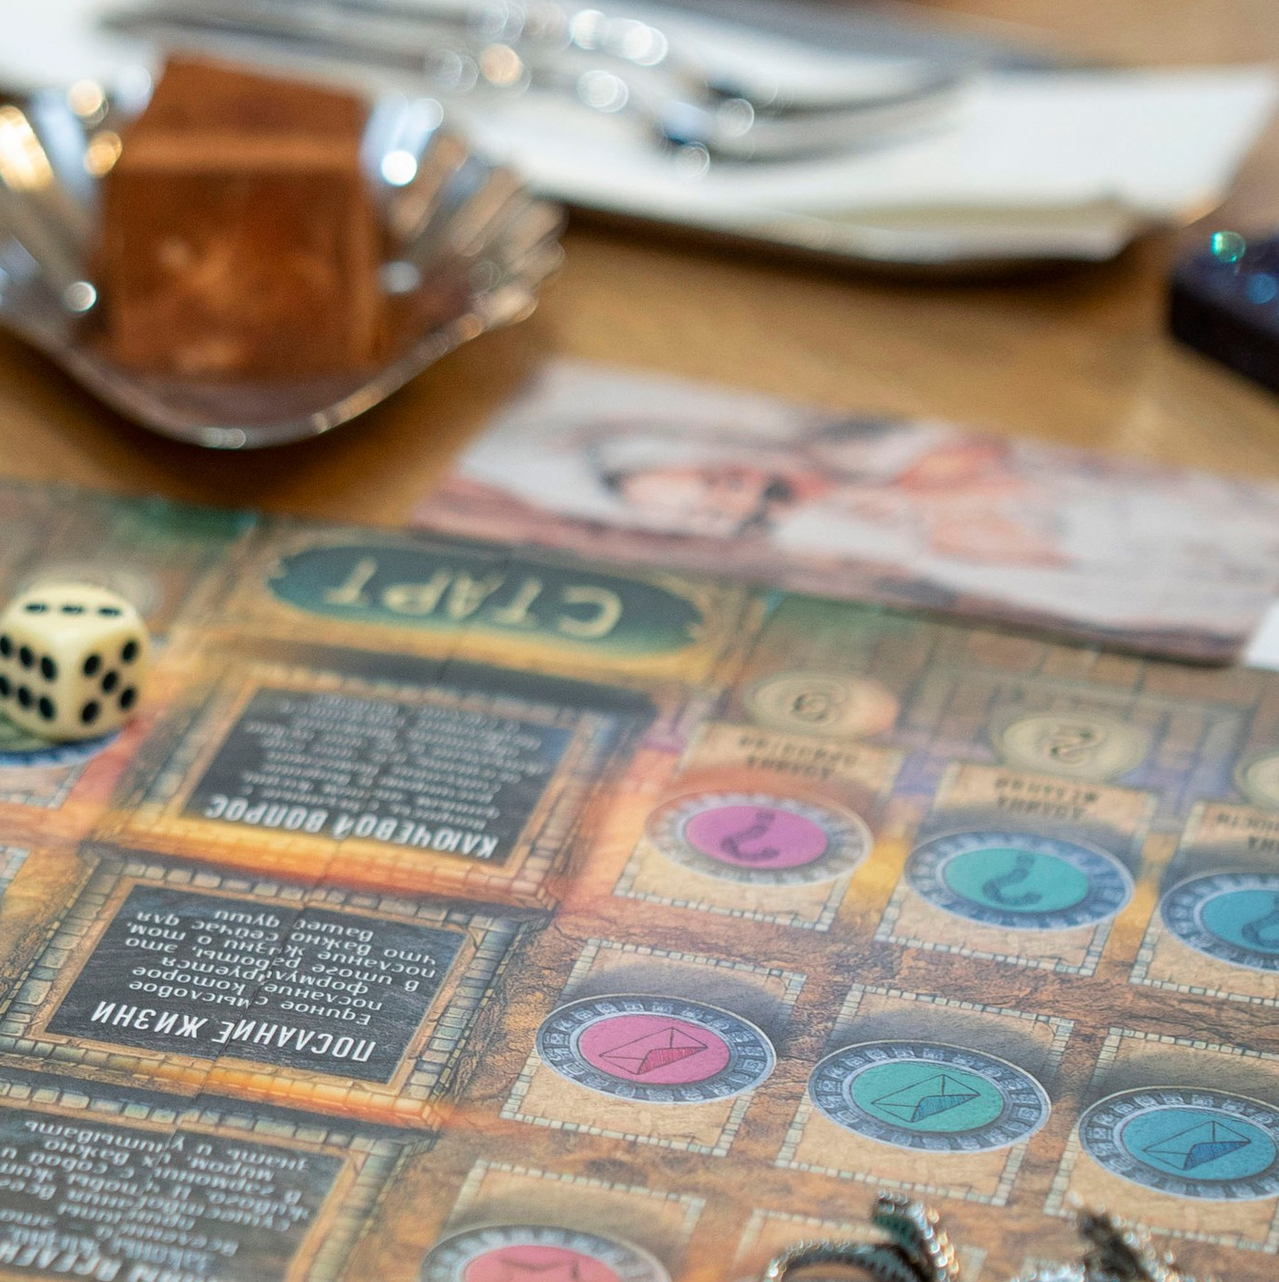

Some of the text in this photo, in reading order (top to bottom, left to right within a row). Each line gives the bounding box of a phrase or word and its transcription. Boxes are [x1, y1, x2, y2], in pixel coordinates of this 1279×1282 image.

[325, 555, 622, 639] СТАРТ
[1047, 722, 1107, 765] 2
[205, 796, 497, 857] КЛЮЧЕВОЙ ВОПРОС
[135, 910, 437, 966] что важно сейчас для
[213, 909, 375, 943] вашей души
[124, 936, 421, 993] в итоге работы, это
[126, 921, 435, 978] послание жизни о том,
[132, 967, 382, 1011] послание, которое
[162, 957, 368, 996] формулируется
[129, 981, 371, 1026] Единое смысловое
[92, 1001, 375, 1061] ПОСЛАНИЕ ЖИЗНИ
[0, 1146, 18, 1160] и
[28, 1151, 109, 1175] собой
[44, 1139, 130, 1165] важно
[195, 1143, 214, 1157] и
[226, 1148, 307, 1172] знать
[119, 1166, 136, 1180] с
[155, 1168, 274, 1195] гармонии
